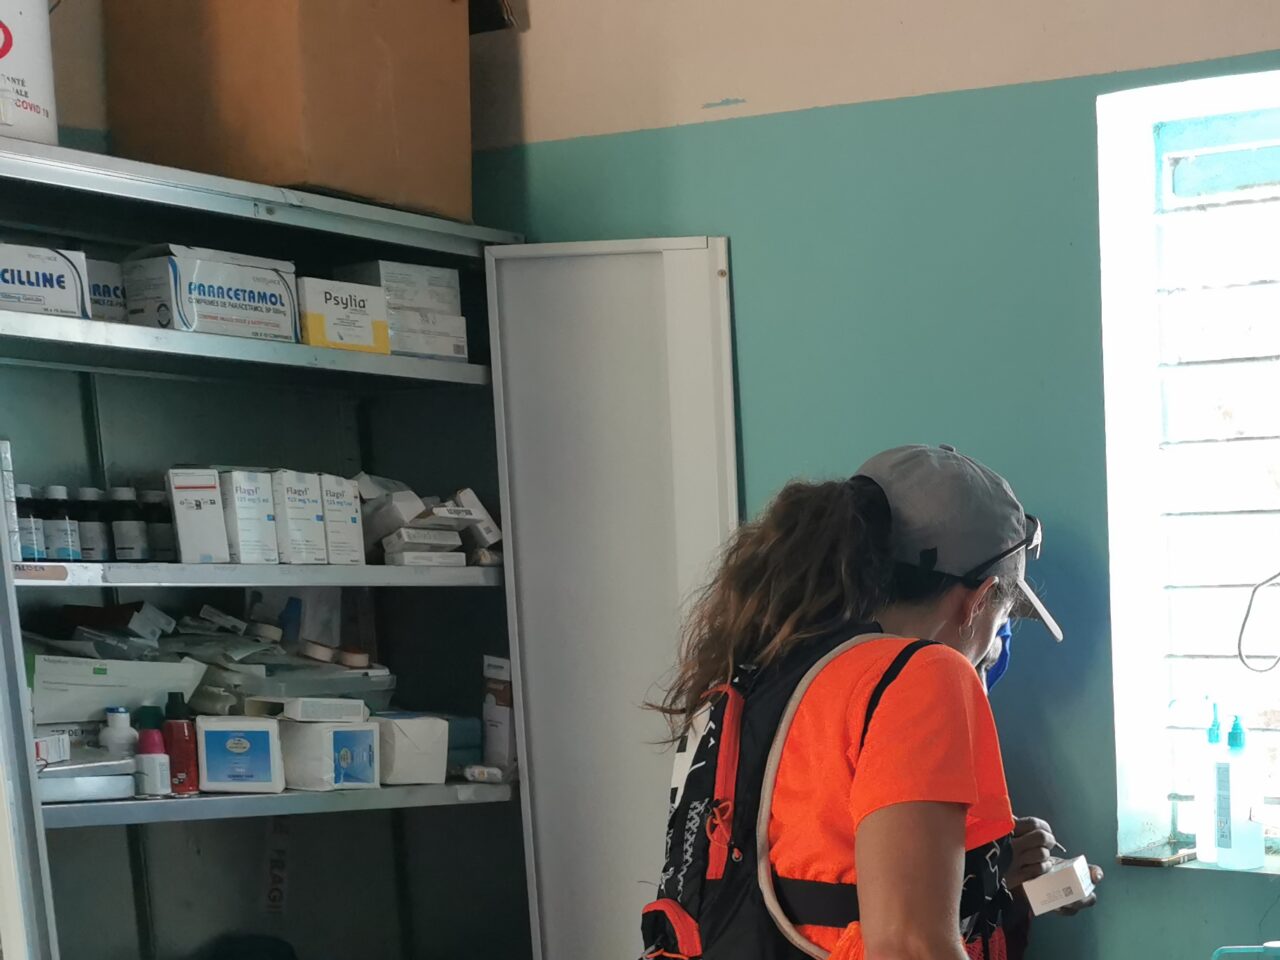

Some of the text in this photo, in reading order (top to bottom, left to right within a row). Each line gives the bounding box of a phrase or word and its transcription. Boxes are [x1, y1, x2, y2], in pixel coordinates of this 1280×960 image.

[188, 282, 285, 307] PARACETAMOL
[324, 291, 367, 309] Psylia
[235, 486, 258, 496] Flagyl
[286, 487, 308, 496] Flagyl
[325, 490, 345, 499] Flagyl
